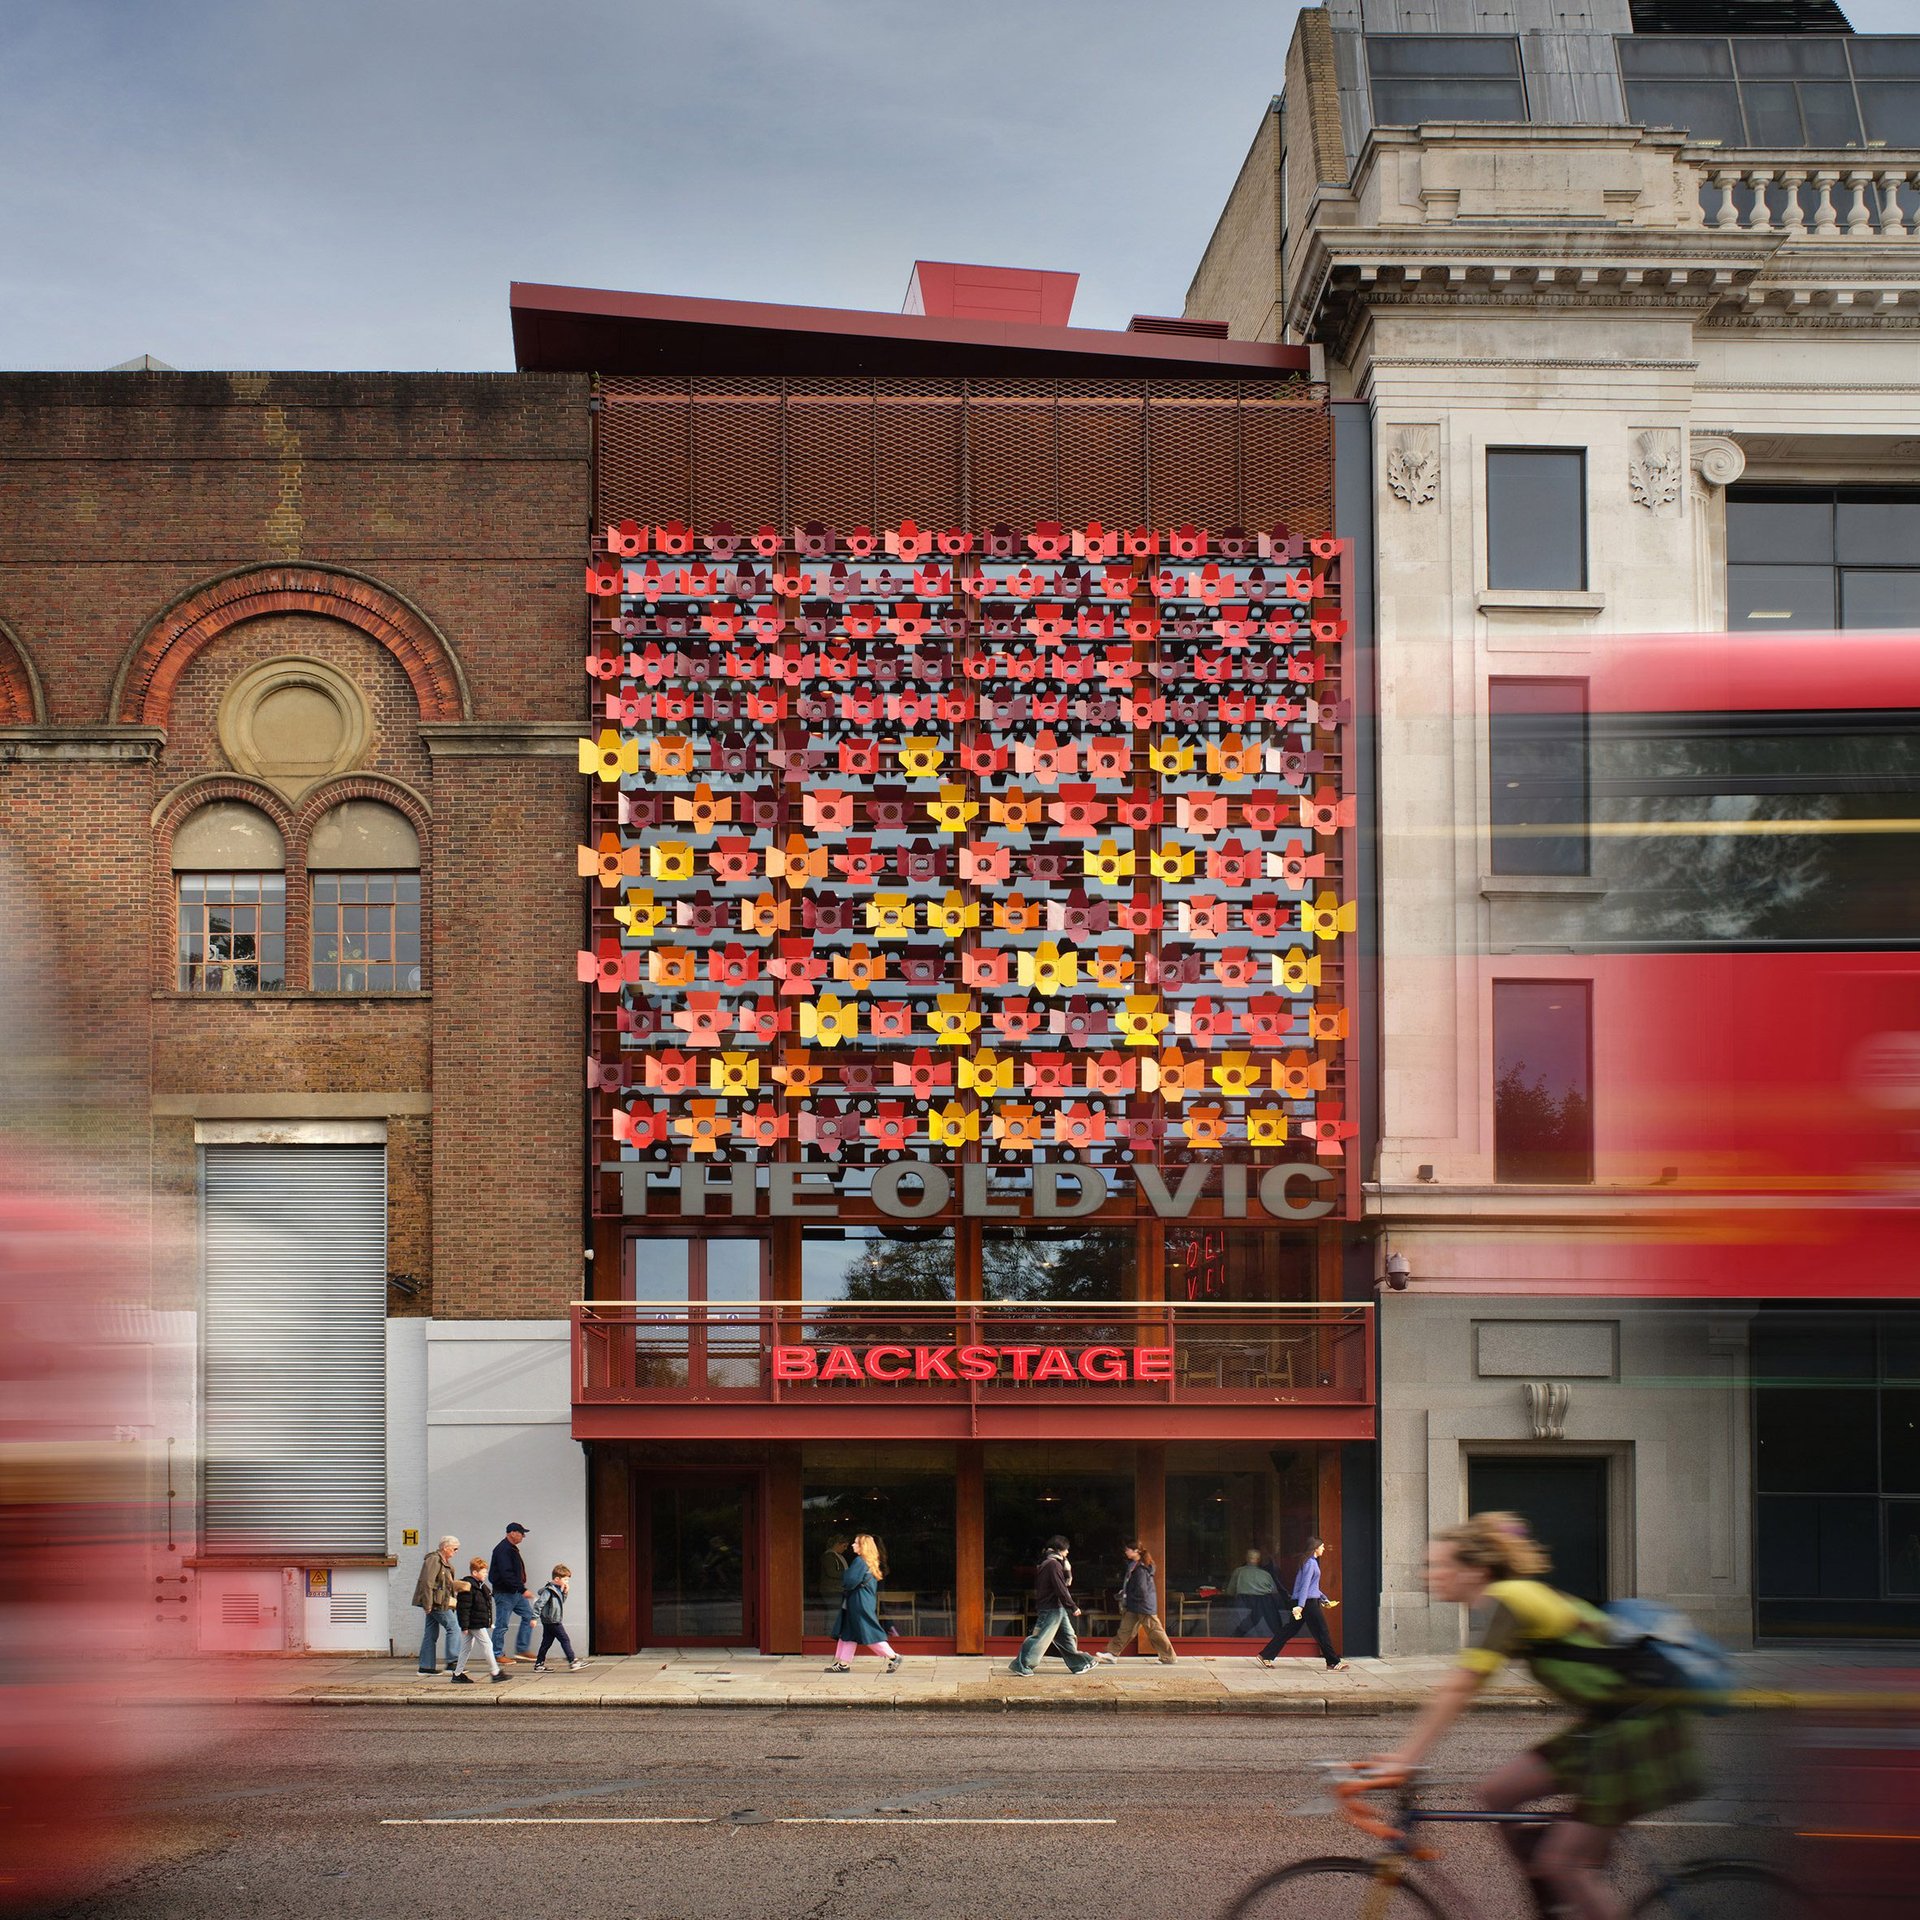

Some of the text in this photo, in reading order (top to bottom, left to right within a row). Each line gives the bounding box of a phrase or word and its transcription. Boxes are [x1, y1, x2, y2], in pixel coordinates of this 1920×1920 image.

[600, 1160, 1337, 1221] THE OLD VIC
[773, 1345, 1174, 1381] BACKSTAGE
[402, 1530, 419, 1545] H
